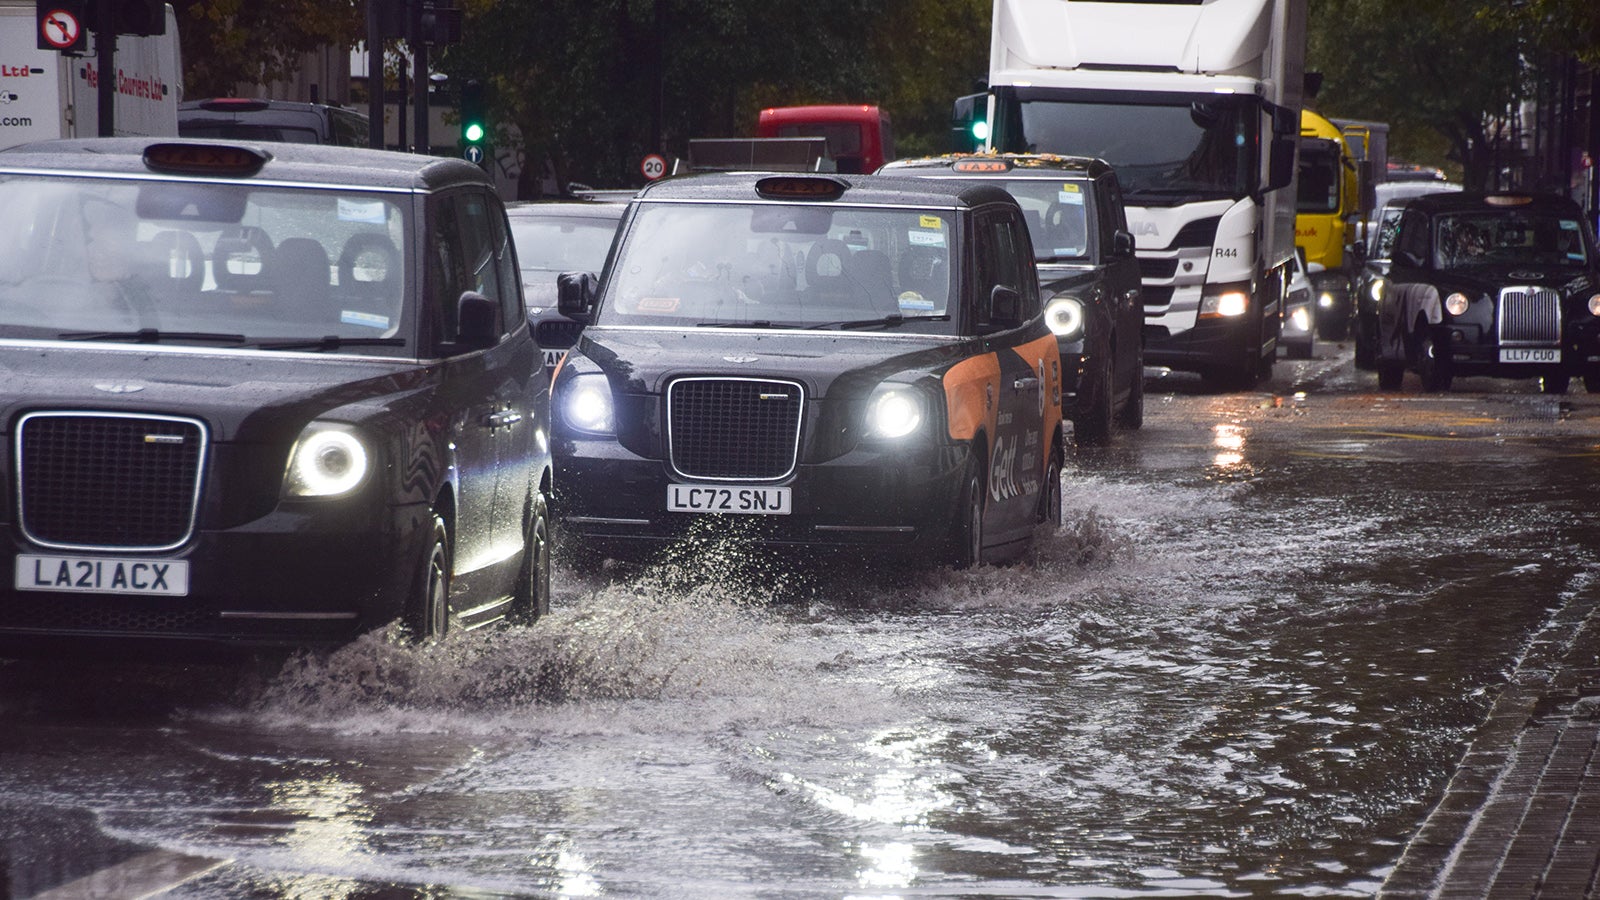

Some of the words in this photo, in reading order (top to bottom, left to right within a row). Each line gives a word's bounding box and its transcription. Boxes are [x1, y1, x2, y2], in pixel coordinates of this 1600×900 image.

[2, 64, 29, 77] Ltd
[119, 69, 149, 99] Couriers
[151, 75, 163, 101] Ltd
[0, 117, 32, 127] .com
[645, 162, 663, 174] 20
[957, 161, 1005, 172] TAXI
[1215, 248, 1237, 258] R44
[542, 351, 565, 365] AN
[1506, 350, 1530, 361] LL17
[1533, 350, 1554, 361] CUO
[674, 488, 732, 510] LC72
[738, 489, 782, 511] SNJ
[34, 559, 102, 588] LA21
[111, 562, 170, 591] ACX
